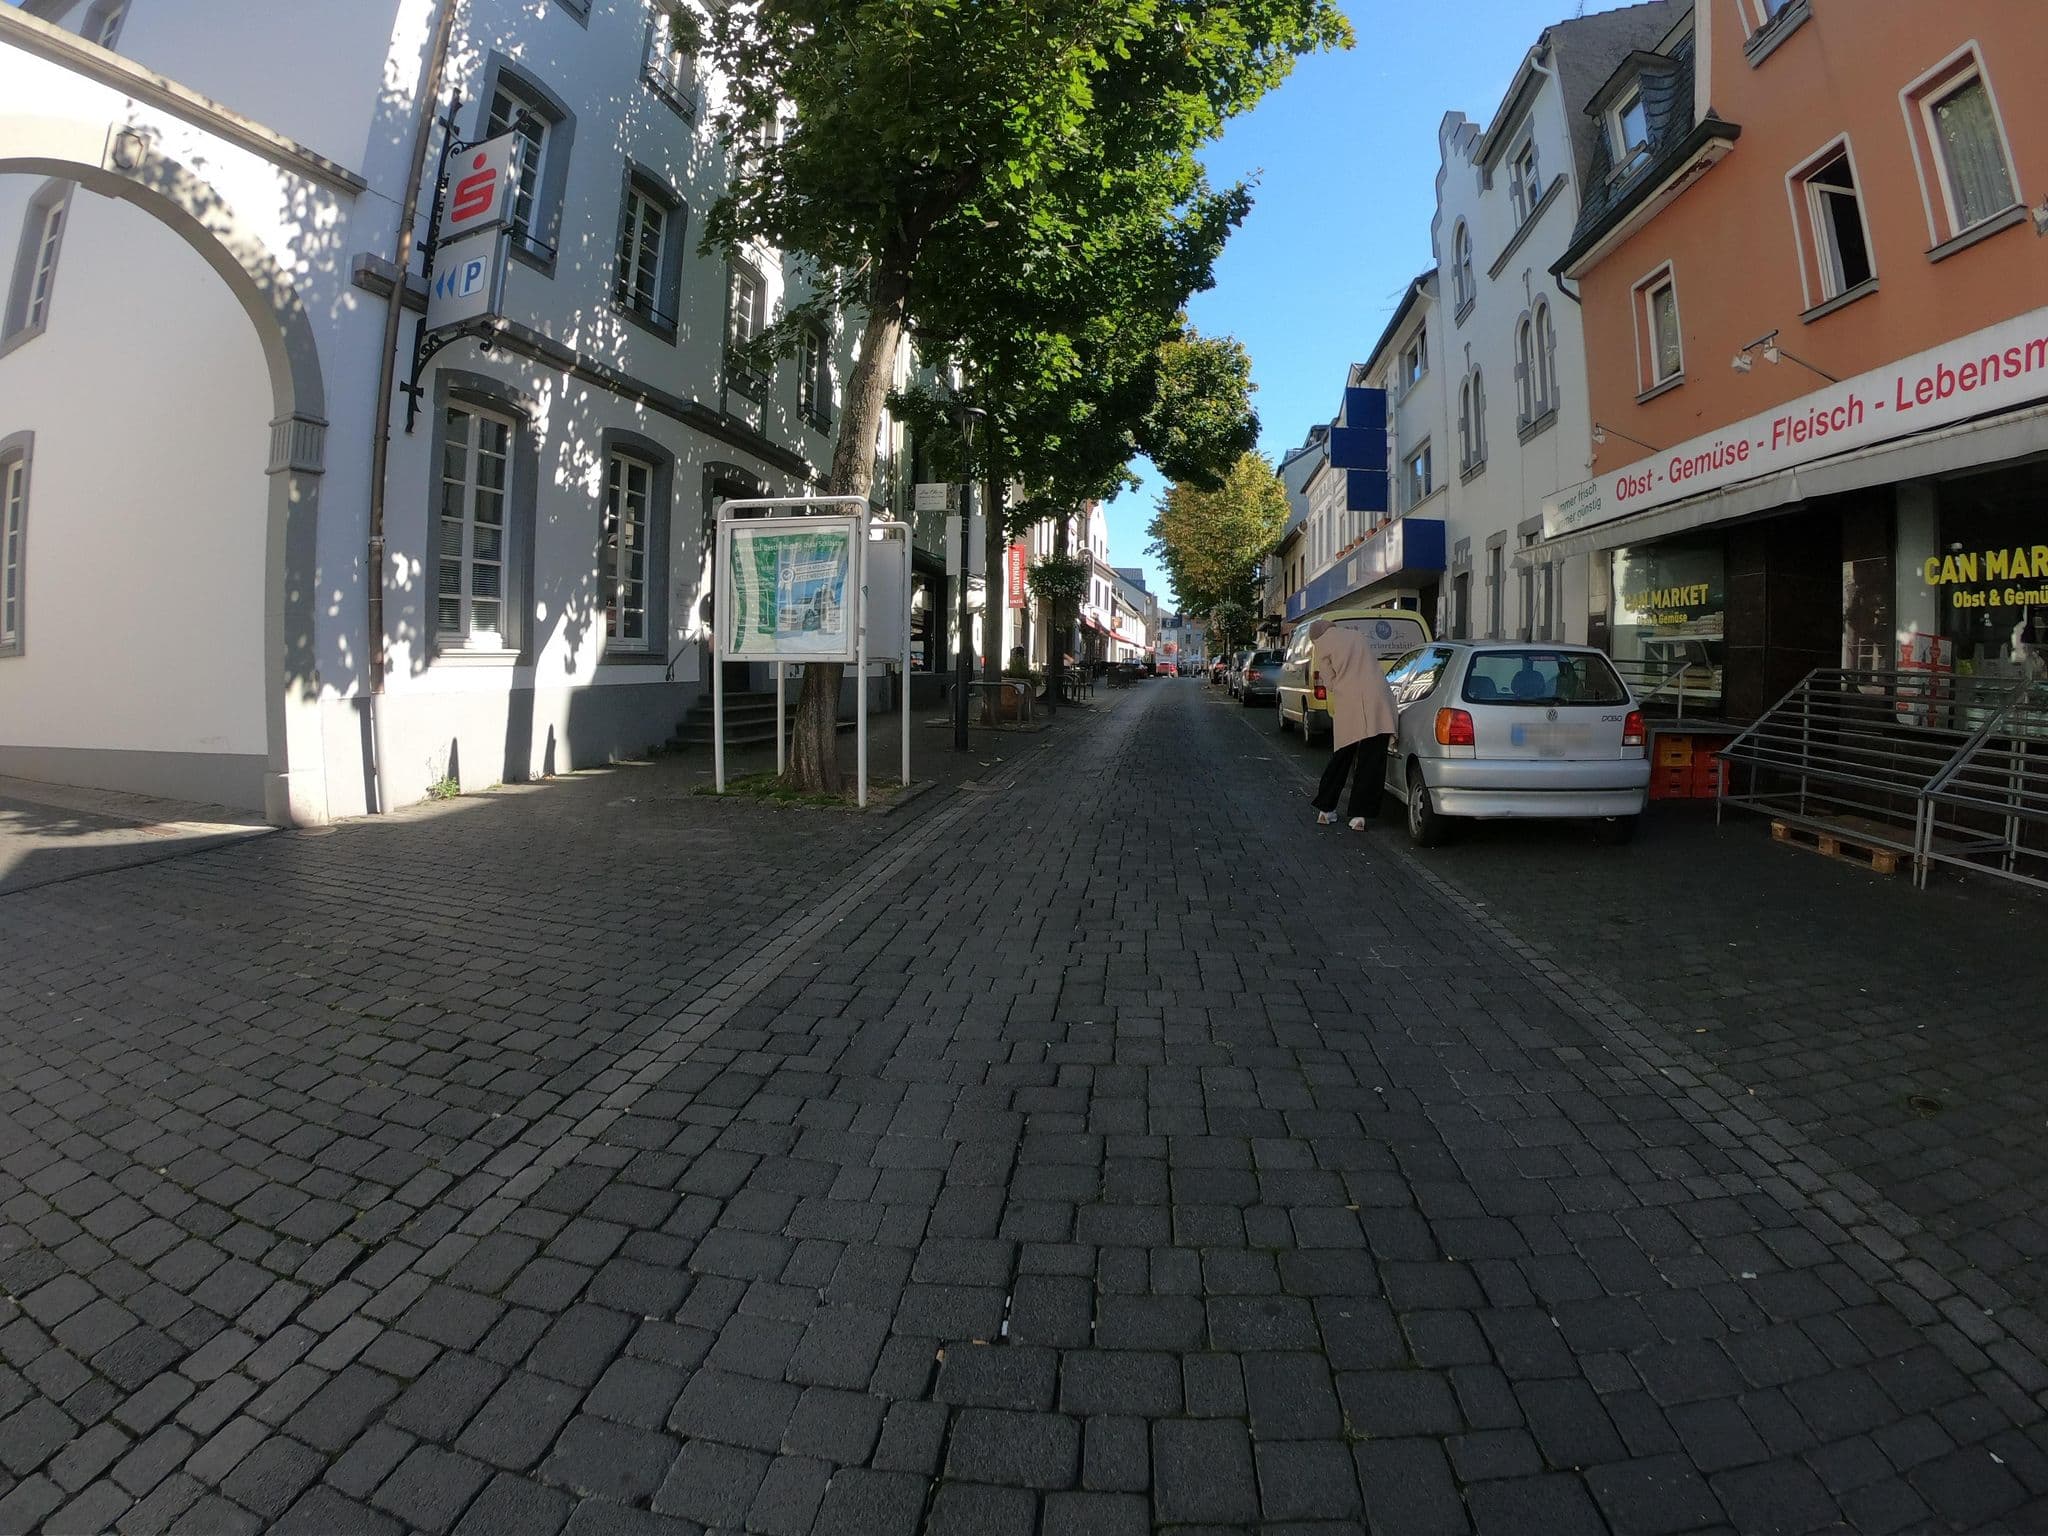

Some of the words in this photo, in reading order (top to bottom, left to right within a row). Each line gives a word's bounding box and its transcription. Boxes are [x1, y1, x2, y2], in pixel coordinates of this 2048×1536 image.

[464, 261, 482, 293] P
[1616, 468, 1653, 501] Obst
[1669, 439, 1750, 484] Gemüse
[1771, 393, 1864, 451] Fleisch
[1012, 551, 1021, 596] INFORMATION
[1924, 552, 1979, 586] CAN
[1985, 545, 2048, 581] MAR
[1651, 583, 1709, 610] MARKET
[1952, 589, 1986, 608] Obst
[1988, 588, 2001, 606] &
